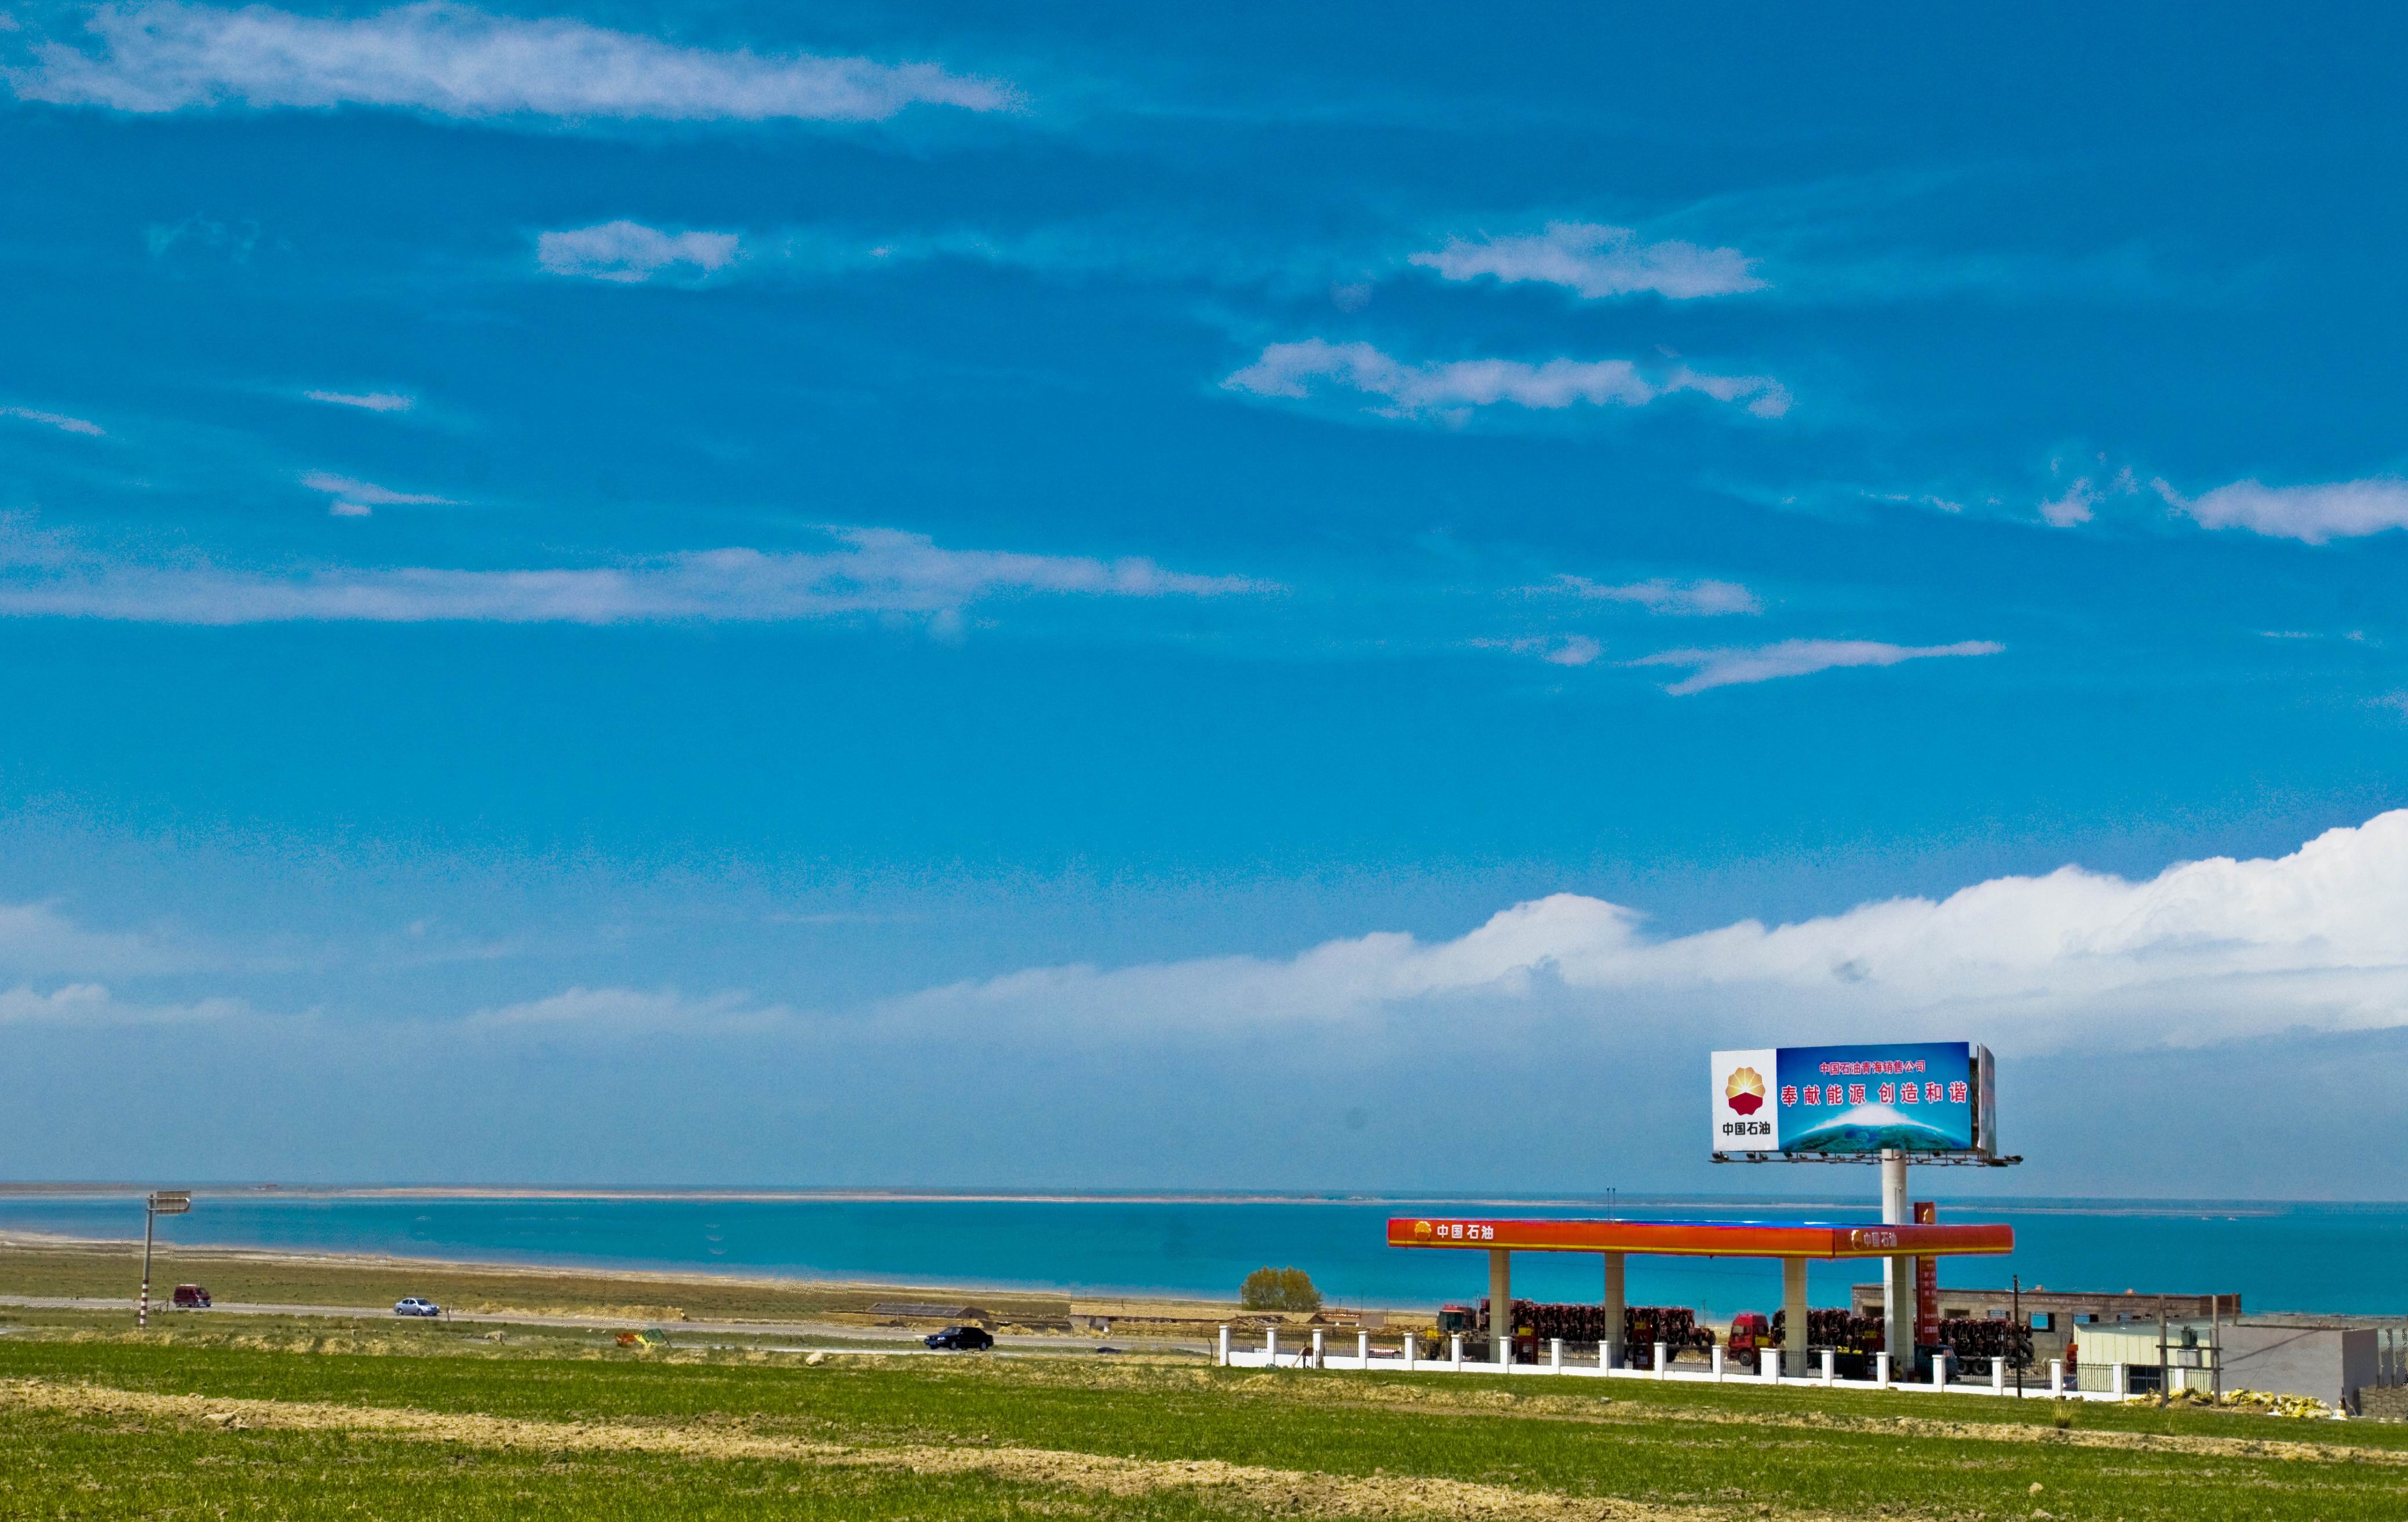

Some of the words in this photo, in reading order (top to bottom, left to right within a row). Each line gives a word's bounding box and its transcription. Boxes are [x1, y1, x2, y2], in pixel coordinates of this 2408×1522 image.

[1820, 1060, 1925, 1075] 中国石油青海销售公司
[1782, 1083, 1866, 1106] 奉献能源
[1878, 1081, 1967, 1104] 创造和谐
[1723, 1121, 1770, 1136] 中国石油
[1437, 1224, 1493, 1239] 中国石油
[1864, 1232, 1897, 1247] 中国石油
